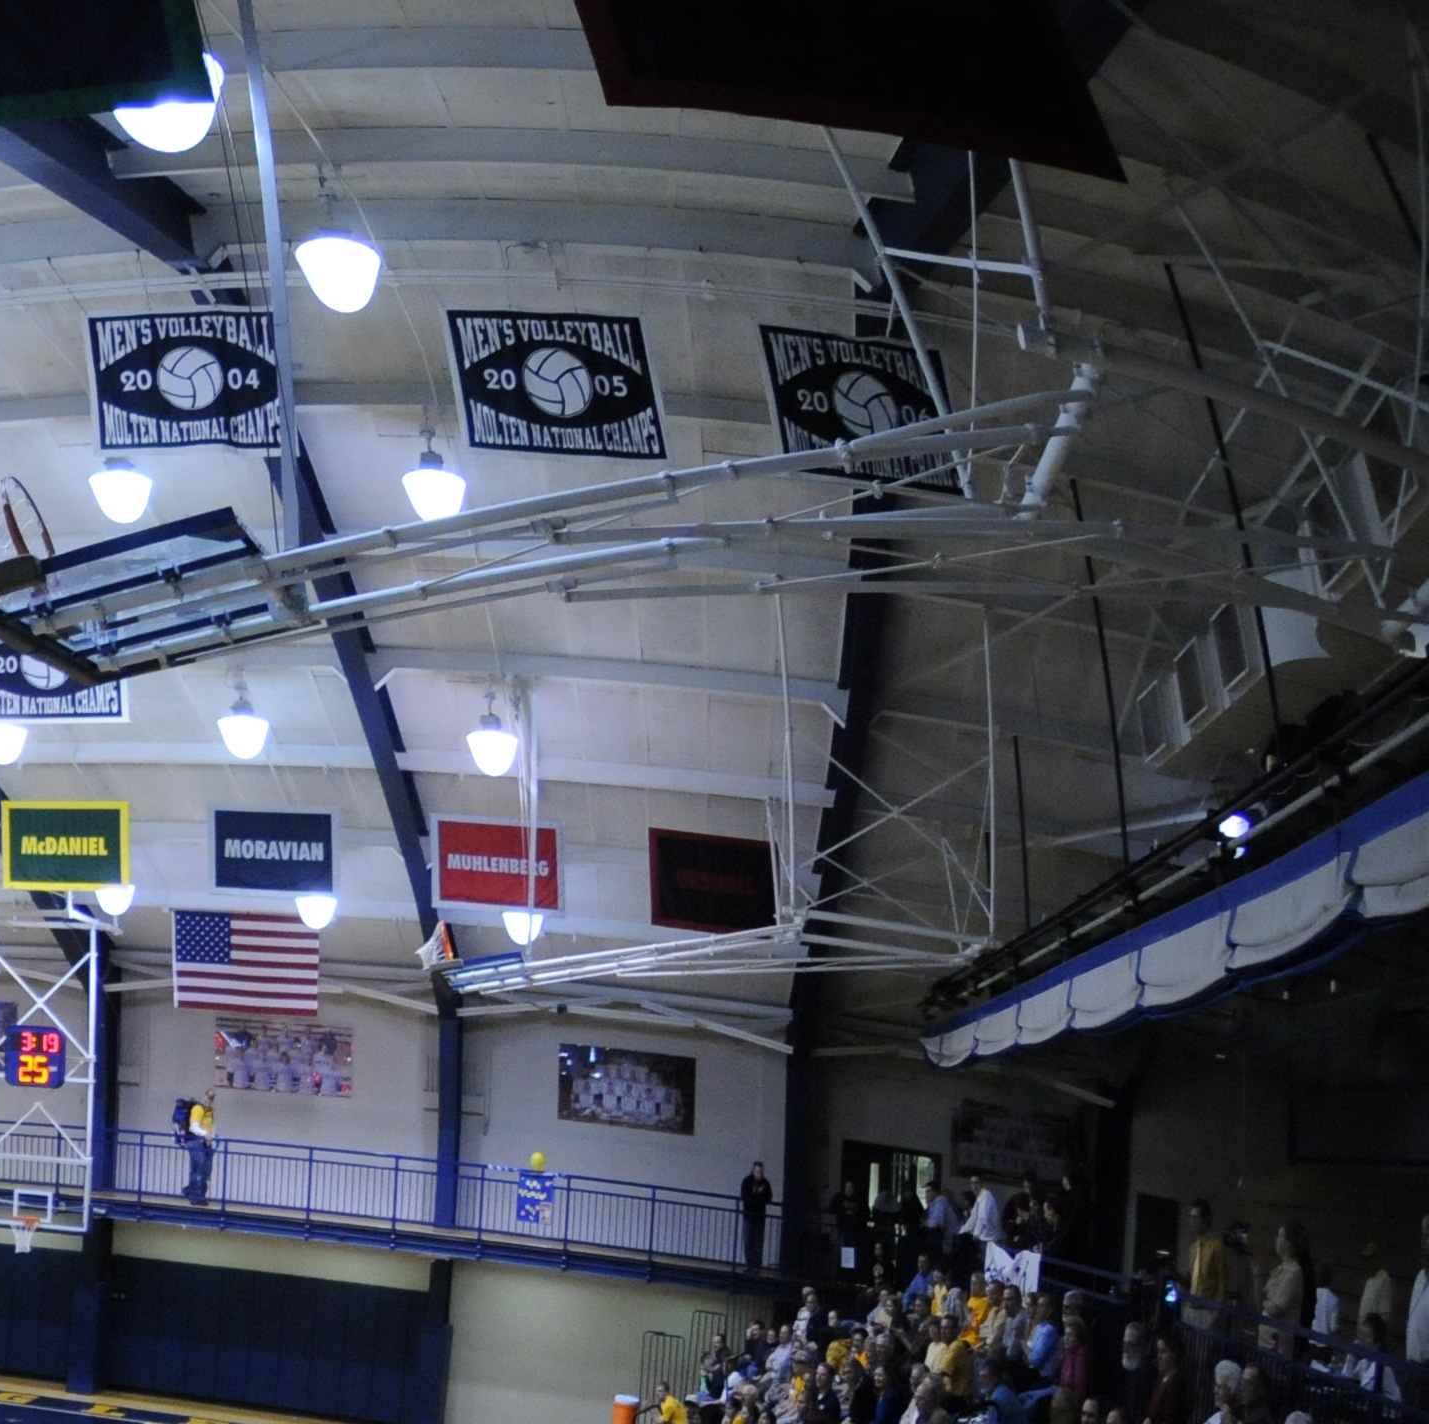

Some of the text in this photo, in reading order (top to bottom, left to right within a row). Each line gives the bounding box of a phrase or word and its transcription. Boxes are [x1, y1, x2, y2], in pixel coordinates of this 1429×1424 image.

[96, 314, 277, 372] MEN'S VOLLEYBALL
[456, 317, 642, 377] MEN'S VOLLEYBALL
[120, 367, 260, 392] 20 04
[768, 332, 931, 396] MEN'S VOLLEYBA
[483, 368, 628, 398] 20 05
[797, 388, 829, 413] 20
[103, 401, 159, 446] MOLTEN
[159, 416, 229, 443] NATIONAL
[469, 397, 660, 455] MOLTEN NATIONAL CHAMPS
[22, 694, 75, 715] NATIONAL
[75, 681, 118, 714] CHAMPS
[21, 835, 108, 857] McDANIEL
[224, 838, 324, 862] MORAVIAN
[18, 1054, 49, 1084] 25
